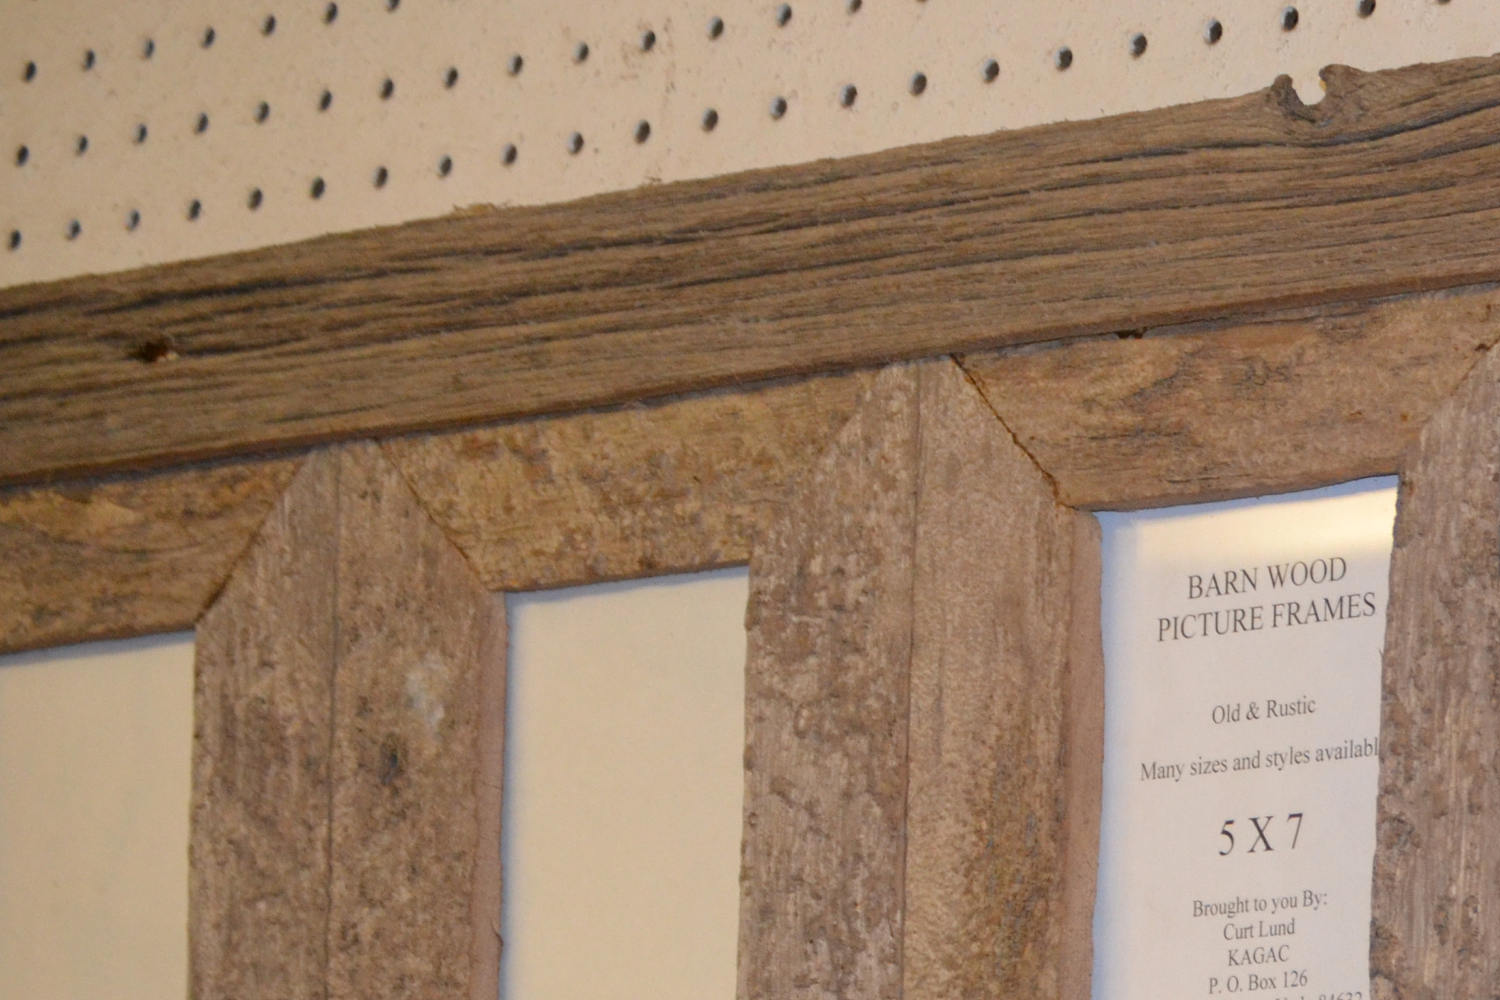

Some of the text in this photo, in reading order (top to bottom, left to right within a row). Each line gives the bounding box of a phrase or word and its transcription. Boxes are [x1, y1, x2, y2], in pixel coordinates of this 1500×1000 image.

[1187, 556, 1348, 600] BARN WOOD
[1157, 592, 1377, 642] PICTURE FRAMES
[1211, 695, 1317, 725] Old & Rustic
[1140, 737, 1379, 783] Many sizes and styles availabl
[1218, 812, 1303, 856] 5 X 7
[1192, 889, 1328, 919] Brought to you By:
[1223, 918, 1295, 942] Curt Lund
[1227, 945, 1290, 967] KAGAC
[1208, 969, 1308, 995] P. O. Box 126
